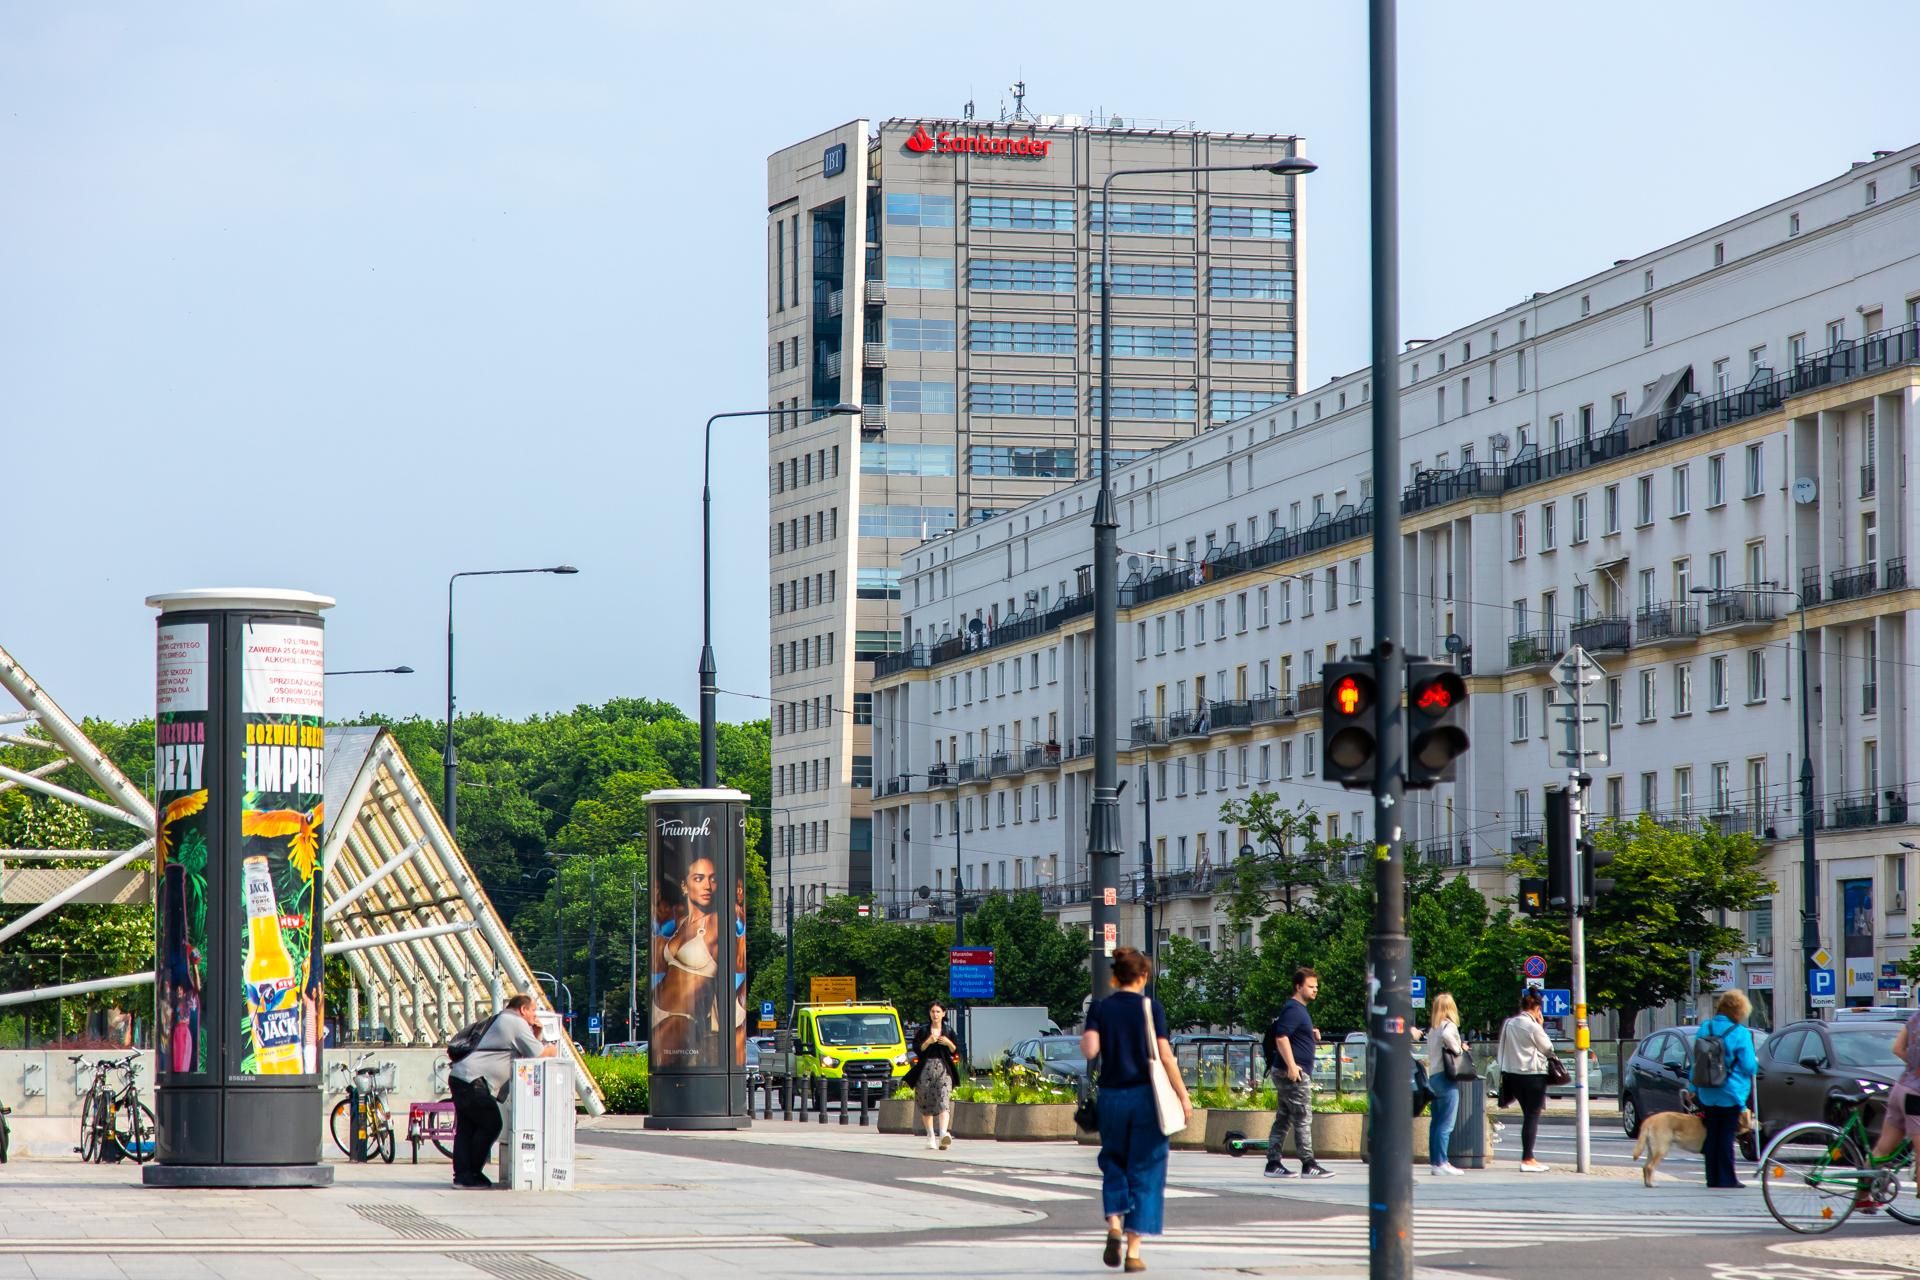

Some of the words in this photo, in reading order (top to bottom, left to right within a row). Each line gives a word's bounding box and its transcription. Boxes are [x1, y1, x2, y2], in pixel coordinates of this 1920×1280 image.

[939, 131, 1053, 157] Santander
[825, 149, 842, 172] IBT
[168, 642, 200, 650] CZYSTEGO
[267, 696, 285, 704] JEST
[246, 719, 298, 746] ROZWIŃ
[655, 817, 711, 843] Triumph
[250, 882, 269, 894] JACK
[280, 918, 300, 927] NEW
[277, 981, 294, 989] NEW
[1815, 972, 1831, 993] P
[763, 1002, 772, 1014] P
[591, 1018, 598, 1027] P
[262, 1018, 298, 1041] JACK
